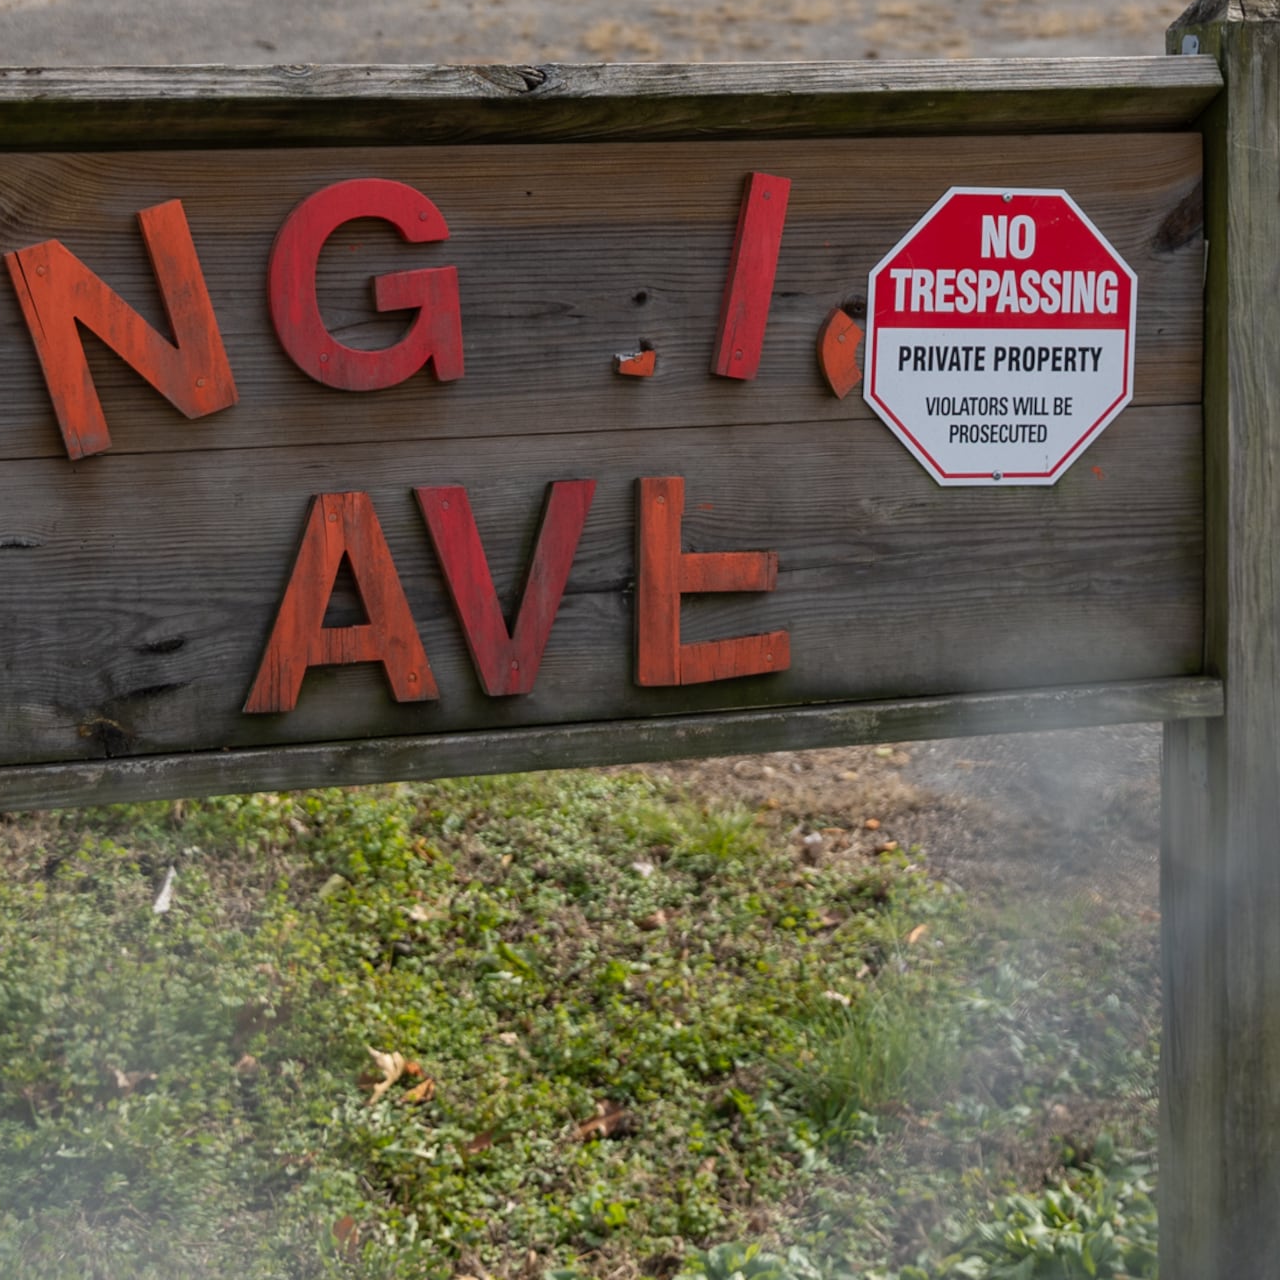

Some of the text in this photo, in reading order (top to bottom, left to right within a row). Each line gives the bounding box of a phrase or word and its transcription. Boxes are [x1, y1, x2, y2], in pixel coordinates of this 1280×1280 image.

[981, 214, 1036, 259] NO
[890, 268, 1118, 314] TRESPASSING
[898, 345, 1102, 372] PRIVATE PROPERTY
[926, 397, 1073, 416] VIOLATORS WILL BE
[949, 424, 1048, 443] PROSECUTED
[243, 476, 792, 713] AVE
